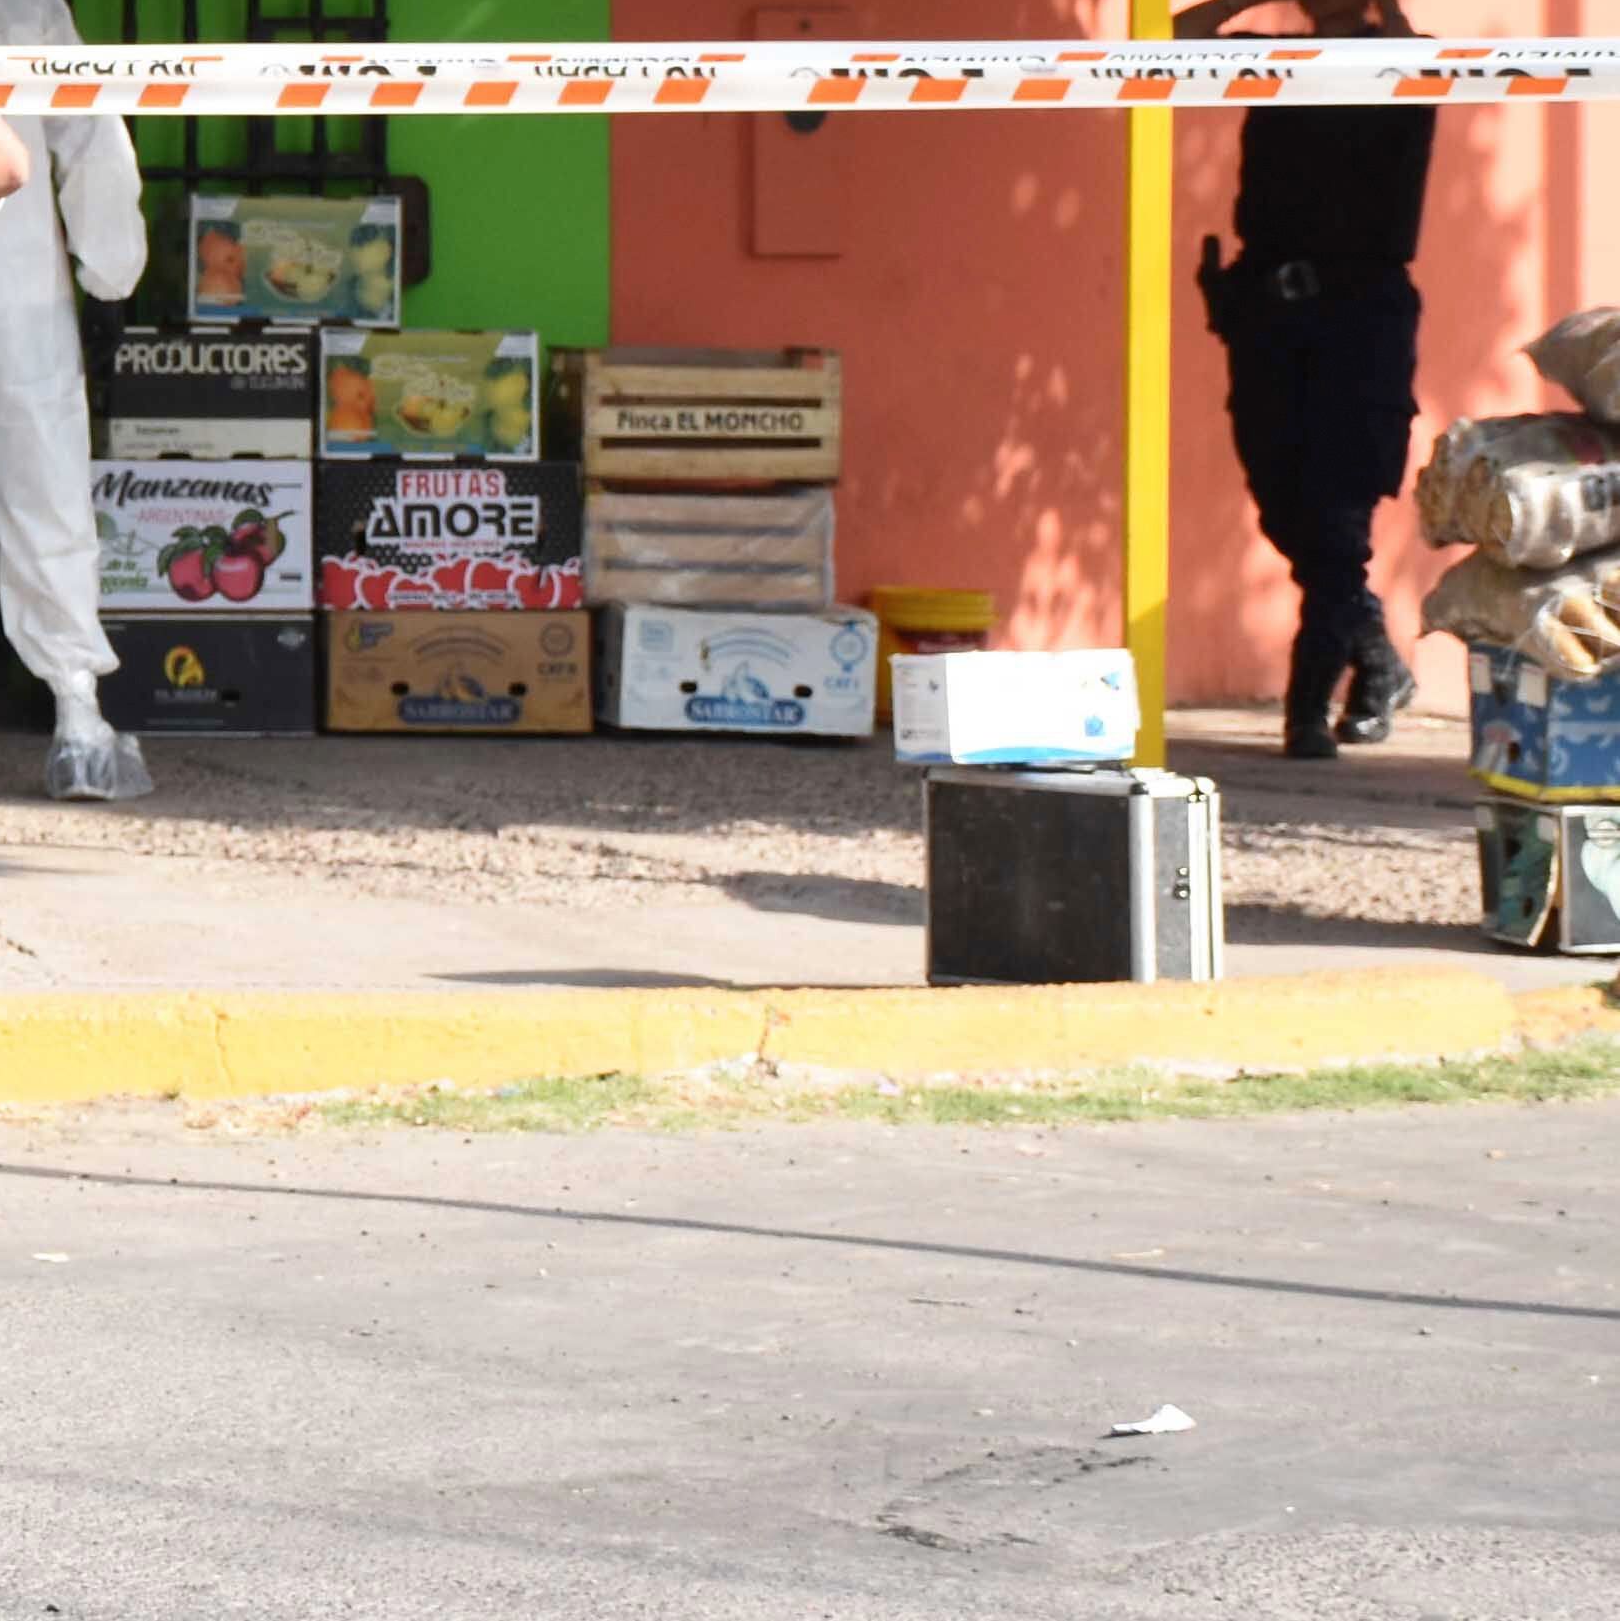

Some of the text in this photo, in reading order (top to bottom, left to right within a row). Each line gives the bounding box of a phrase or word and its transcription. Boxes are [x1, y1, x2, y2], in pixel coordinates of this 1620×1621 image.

[616, 410, 671, 432] Finca
[677, 411, 700, 431] EL
[91, 469, 273, 508] Manzanas
[400, 472, 502, 498] FRUTAS
[370, 502, 534, 537] AMORE
